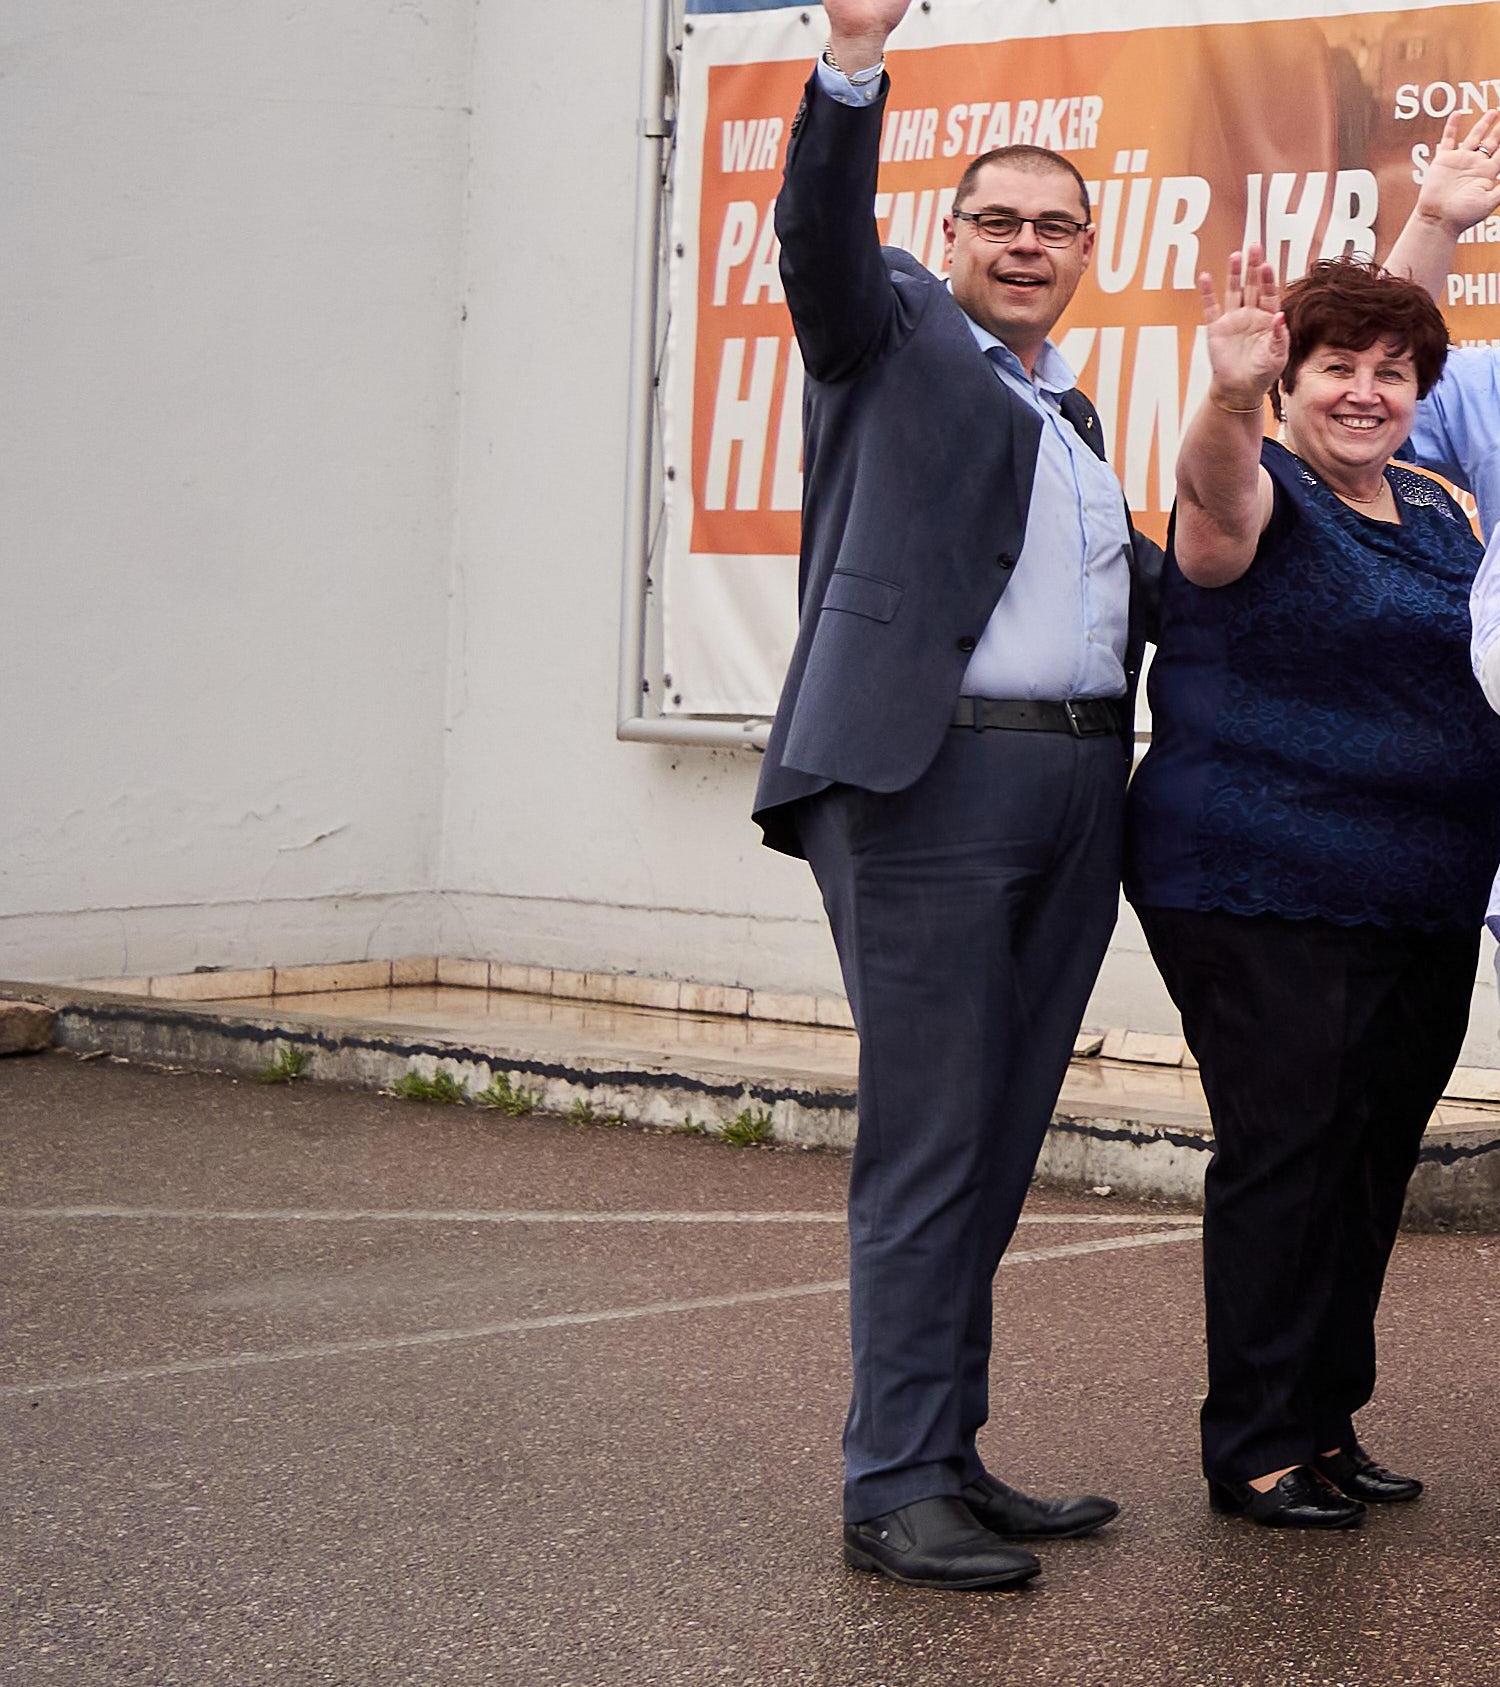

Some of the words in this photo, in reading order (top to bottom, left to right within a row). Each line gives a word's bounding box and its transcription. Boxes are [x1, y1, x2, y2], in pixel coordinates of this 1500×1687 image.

[720, 117, 783, 173] WIR
[878, 106, 939, 163] IHR
[942, 94, 1103, 158] STARKER
[1091, 149, 1212, 294] ÜR
[1239, 168, 1380, 289] IHR
